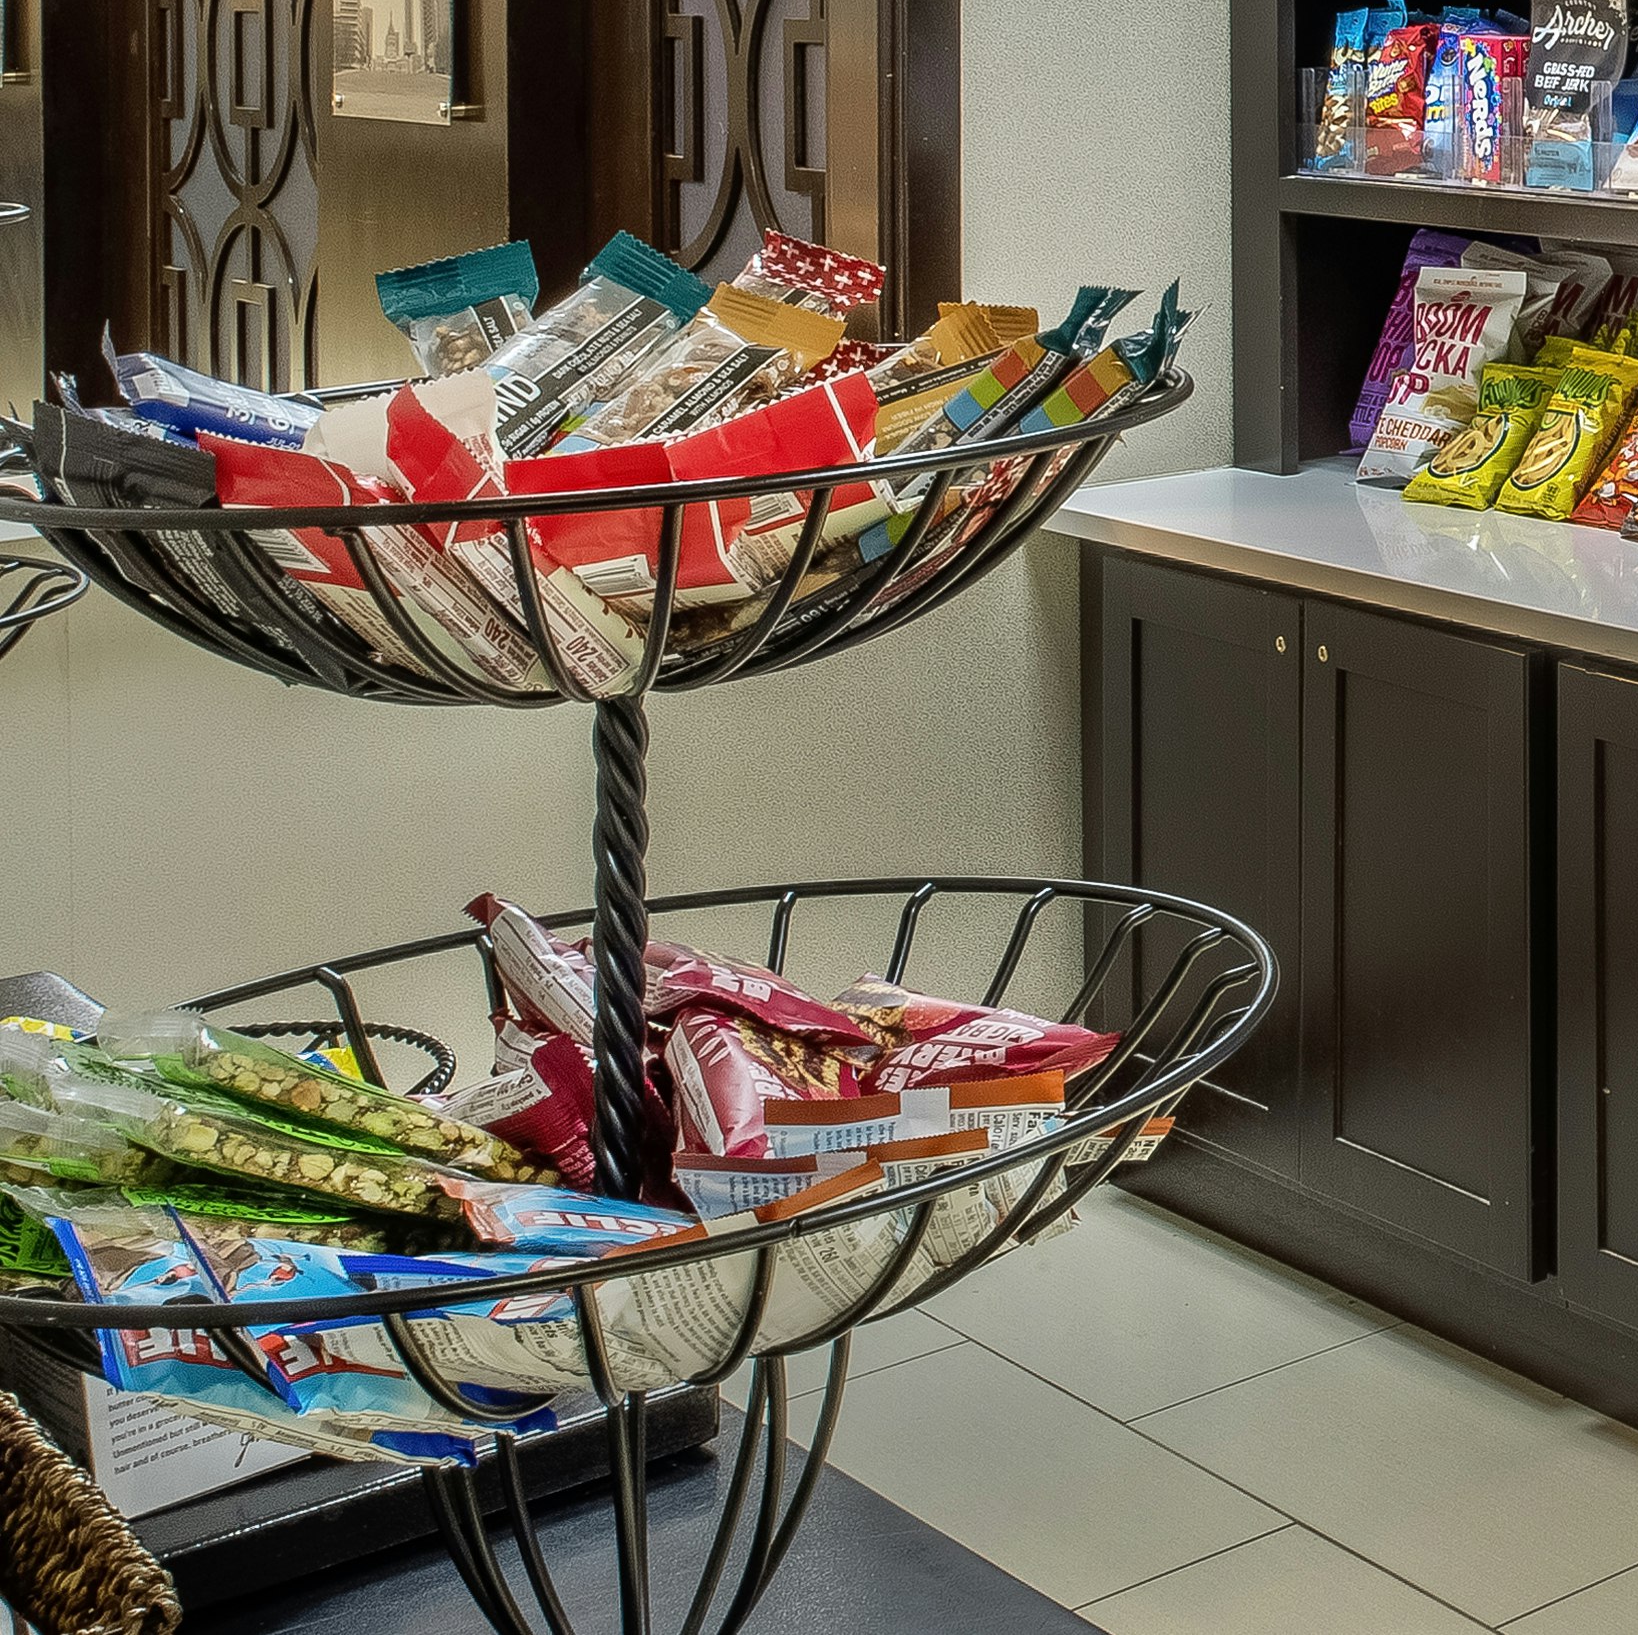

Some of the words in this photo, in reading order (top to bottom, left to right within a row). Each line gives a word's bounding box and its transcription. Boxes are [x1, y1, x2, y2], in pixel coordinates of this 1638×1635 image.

[1565, 0, 1597, 10] COUNTRY
[1531, 4, 1616, 51] Archer
[1467, 53, 1494, 159] Nerds
[1415, 300, 1493, 346] BOOM
[551, 365, 571, 380] DARK
[629, 307, 644, 324] SALT
[652, 405, 689, 435] CARAMEL
[684, 382, 716, 410] ALMOND
[720, 364, 735, 381] SEA
[731, 352, 750, 371] SALT
[704, 378, 735, 405] ALMONDS
[510, 422, 528, 442] SUGAR
[539, 398, 562, 421] PROTEIN
[1385, 417, 1453, 448] CHEDDAR
[531, 1211, 660, 1237] CLIF
[107, 1397, 135, 1412] butter
[109, 1416, 126, 1429] you
[112, 1433, 169, 1459] Unmentioned
[170, 1428, 184, 1440] but
[186, 1421, 201, 1435] still
[114, 1463, 131, 1475] hair
[132, 1455, 149, 1469] and
[161, 1443, 192, 1459] course,
